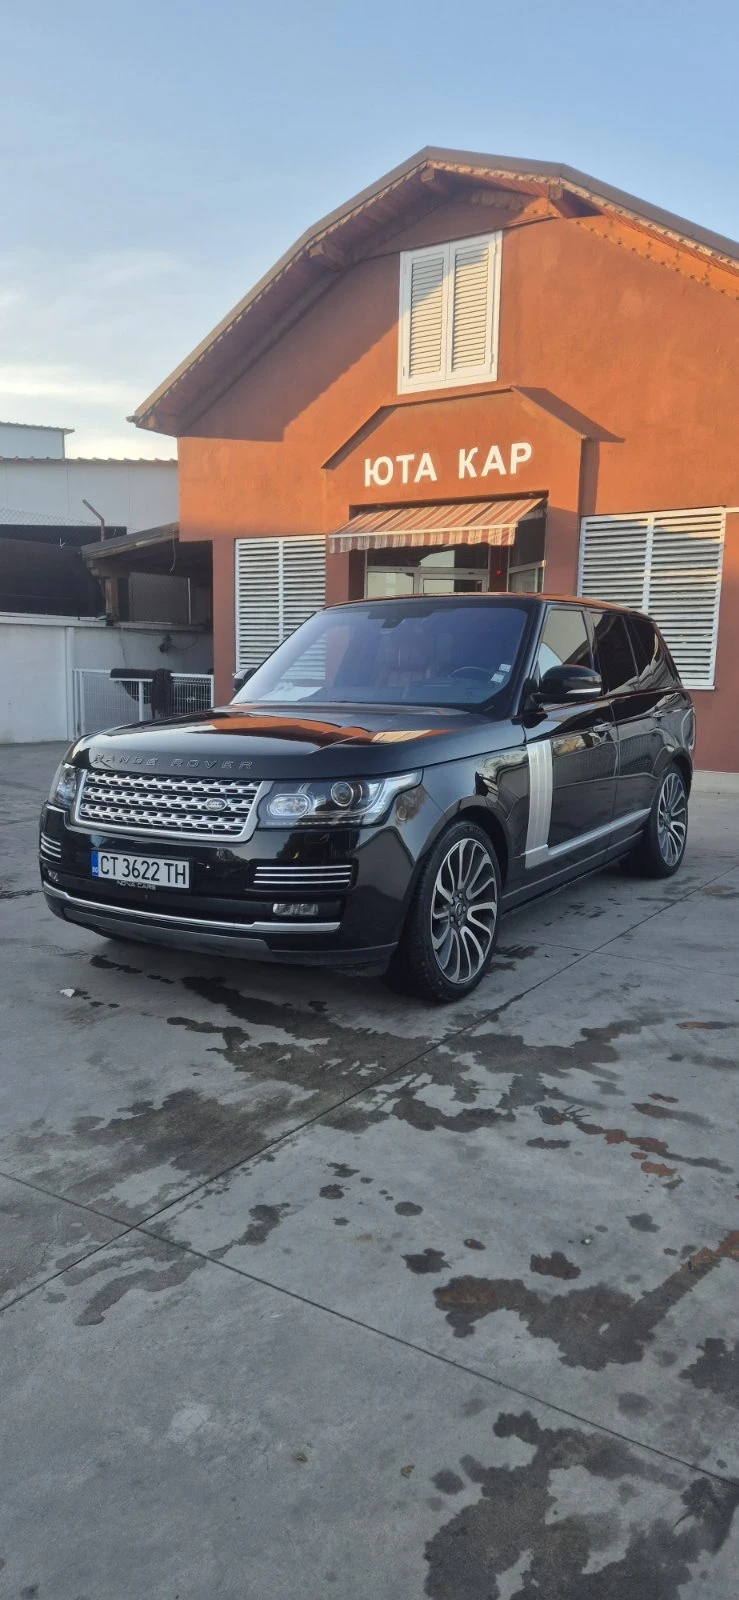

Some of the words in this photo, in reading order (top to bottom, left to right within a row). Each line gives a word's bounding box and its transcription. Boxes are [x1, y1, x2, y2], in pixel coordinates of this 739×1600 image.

[364, 452, 438, 487] ЮТА
[458, 442, 532, 479] КАР
[170, 758, 253, 770] ROVER
[100, 855, 119, 876] CT
[122, 858, 160, 882] 3622
[164, 862, 186, 885] TH
